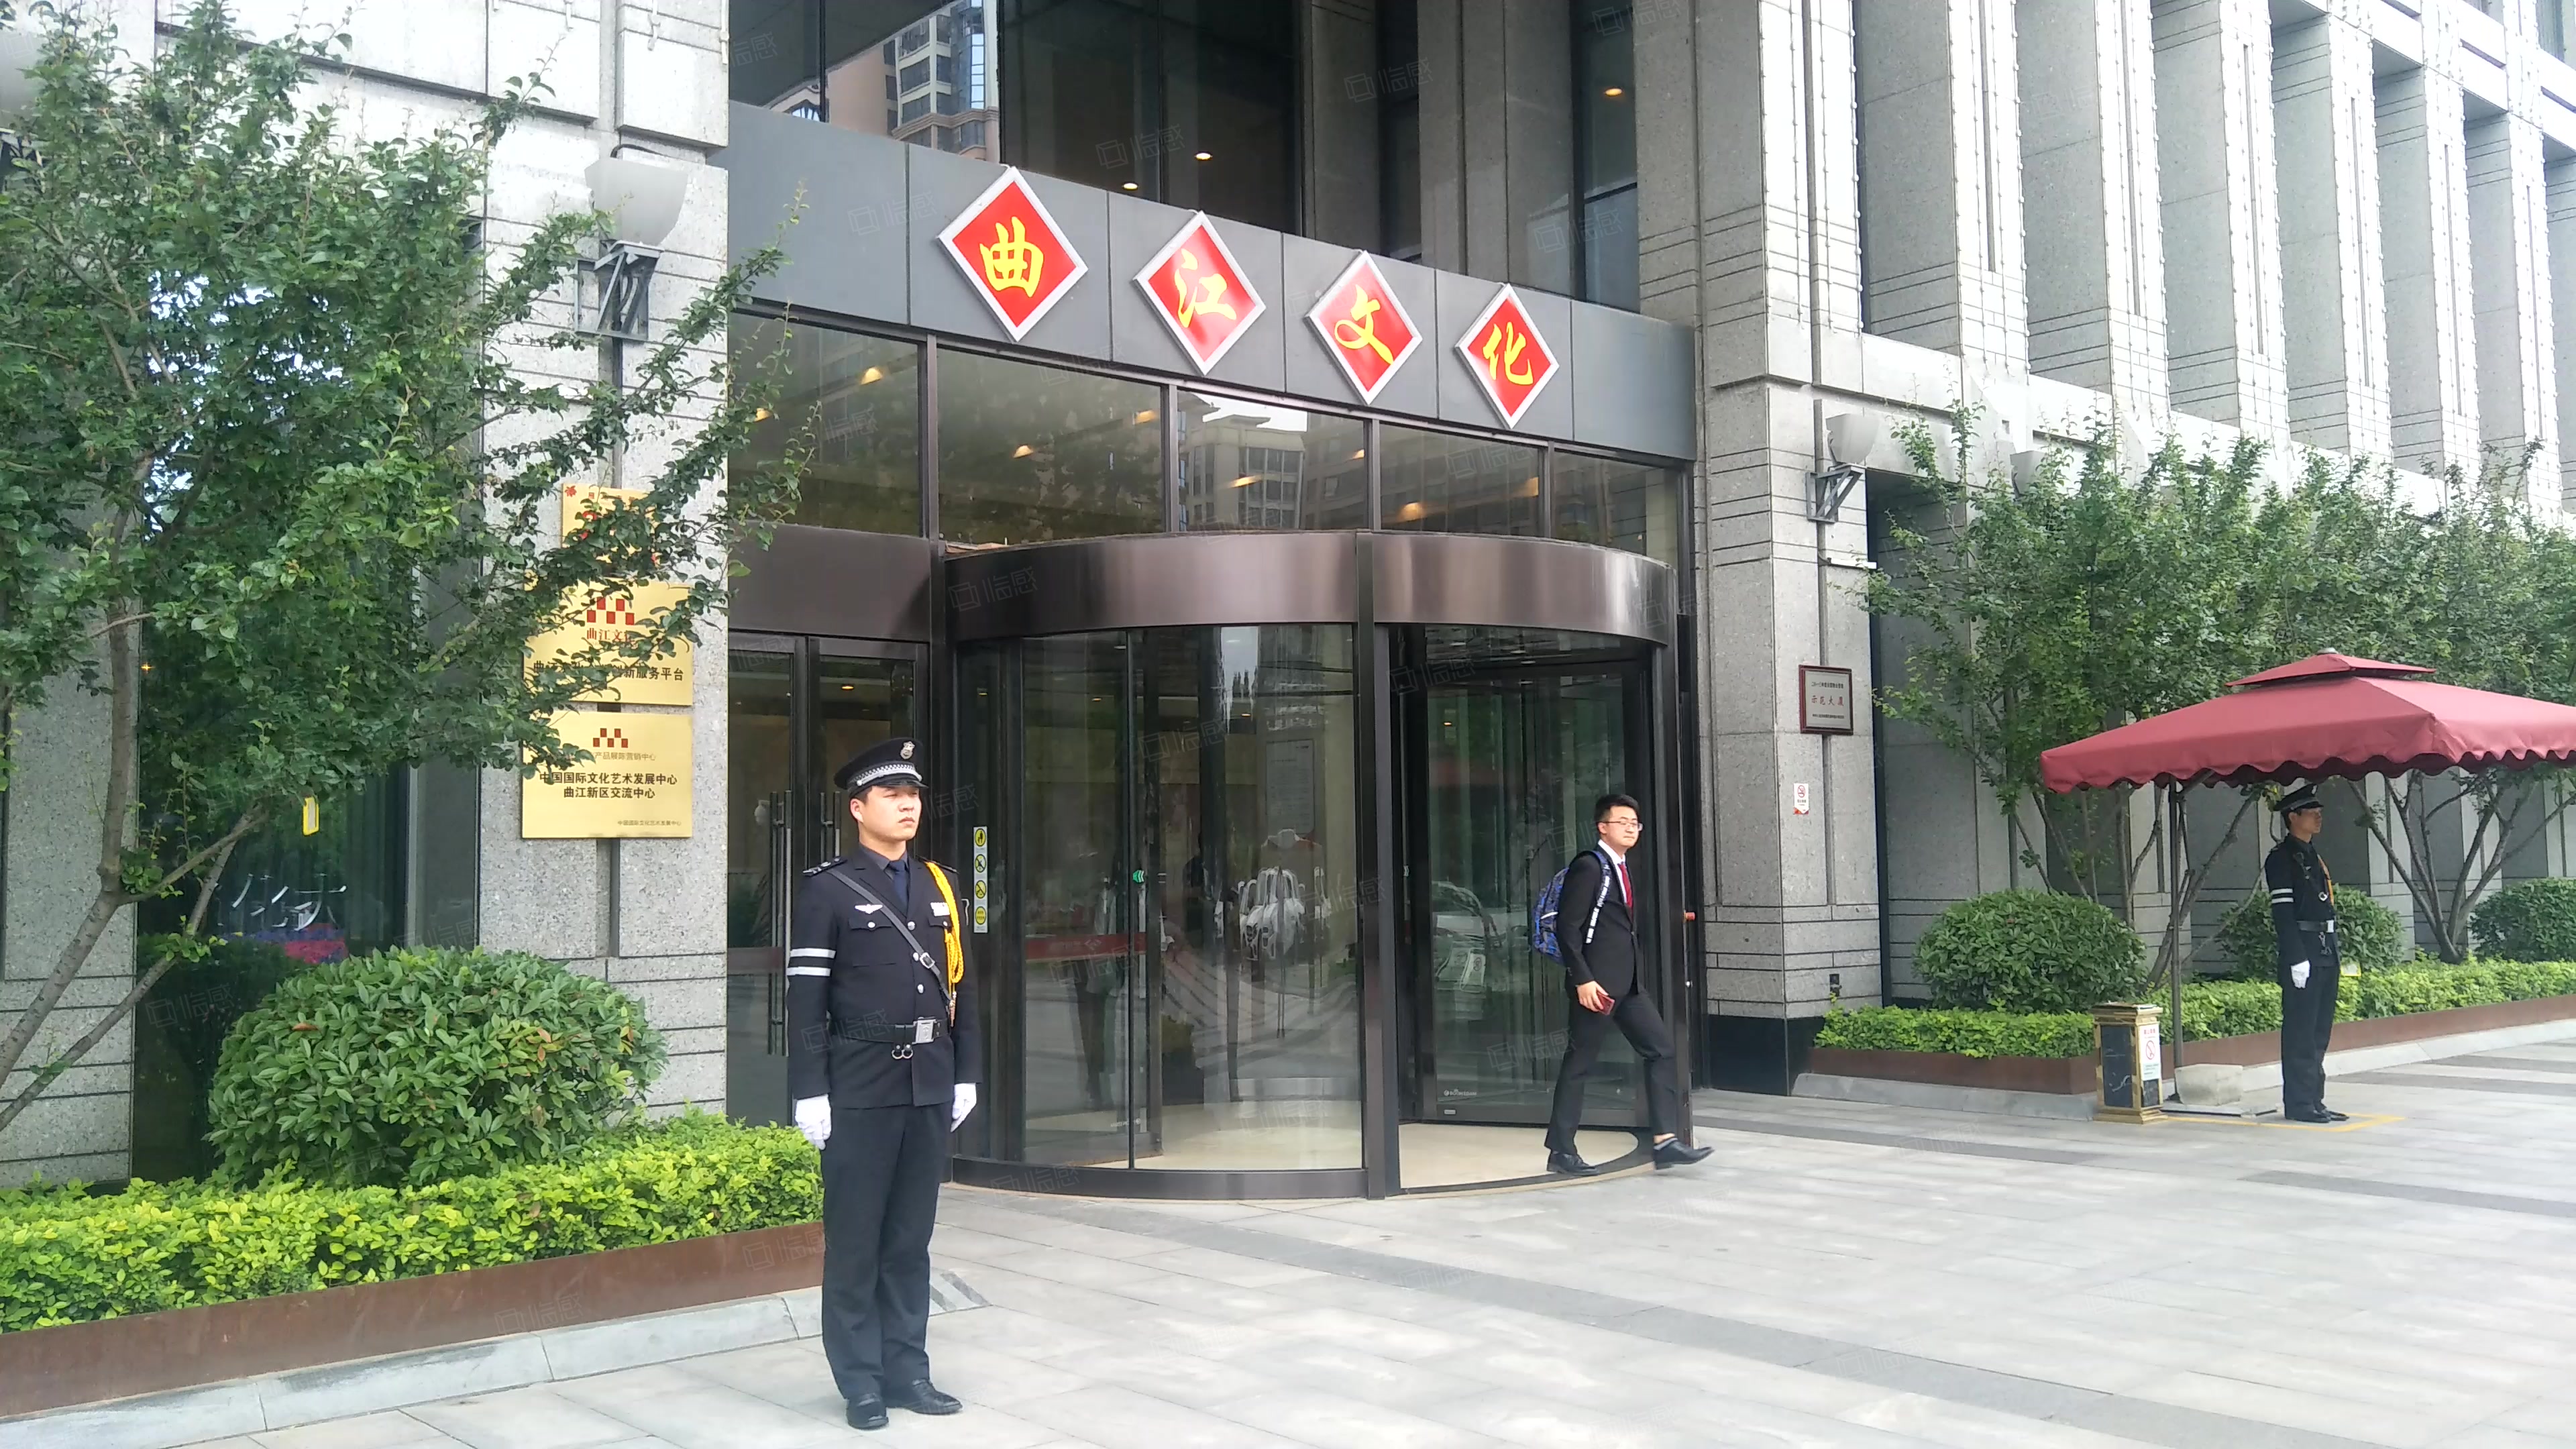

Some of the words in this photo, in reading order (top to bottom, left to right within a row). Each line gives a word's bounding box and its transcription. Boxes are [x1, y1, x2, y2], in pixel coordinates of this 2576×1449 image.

[564, 787, 655, 799] 曲江新区交流中心
